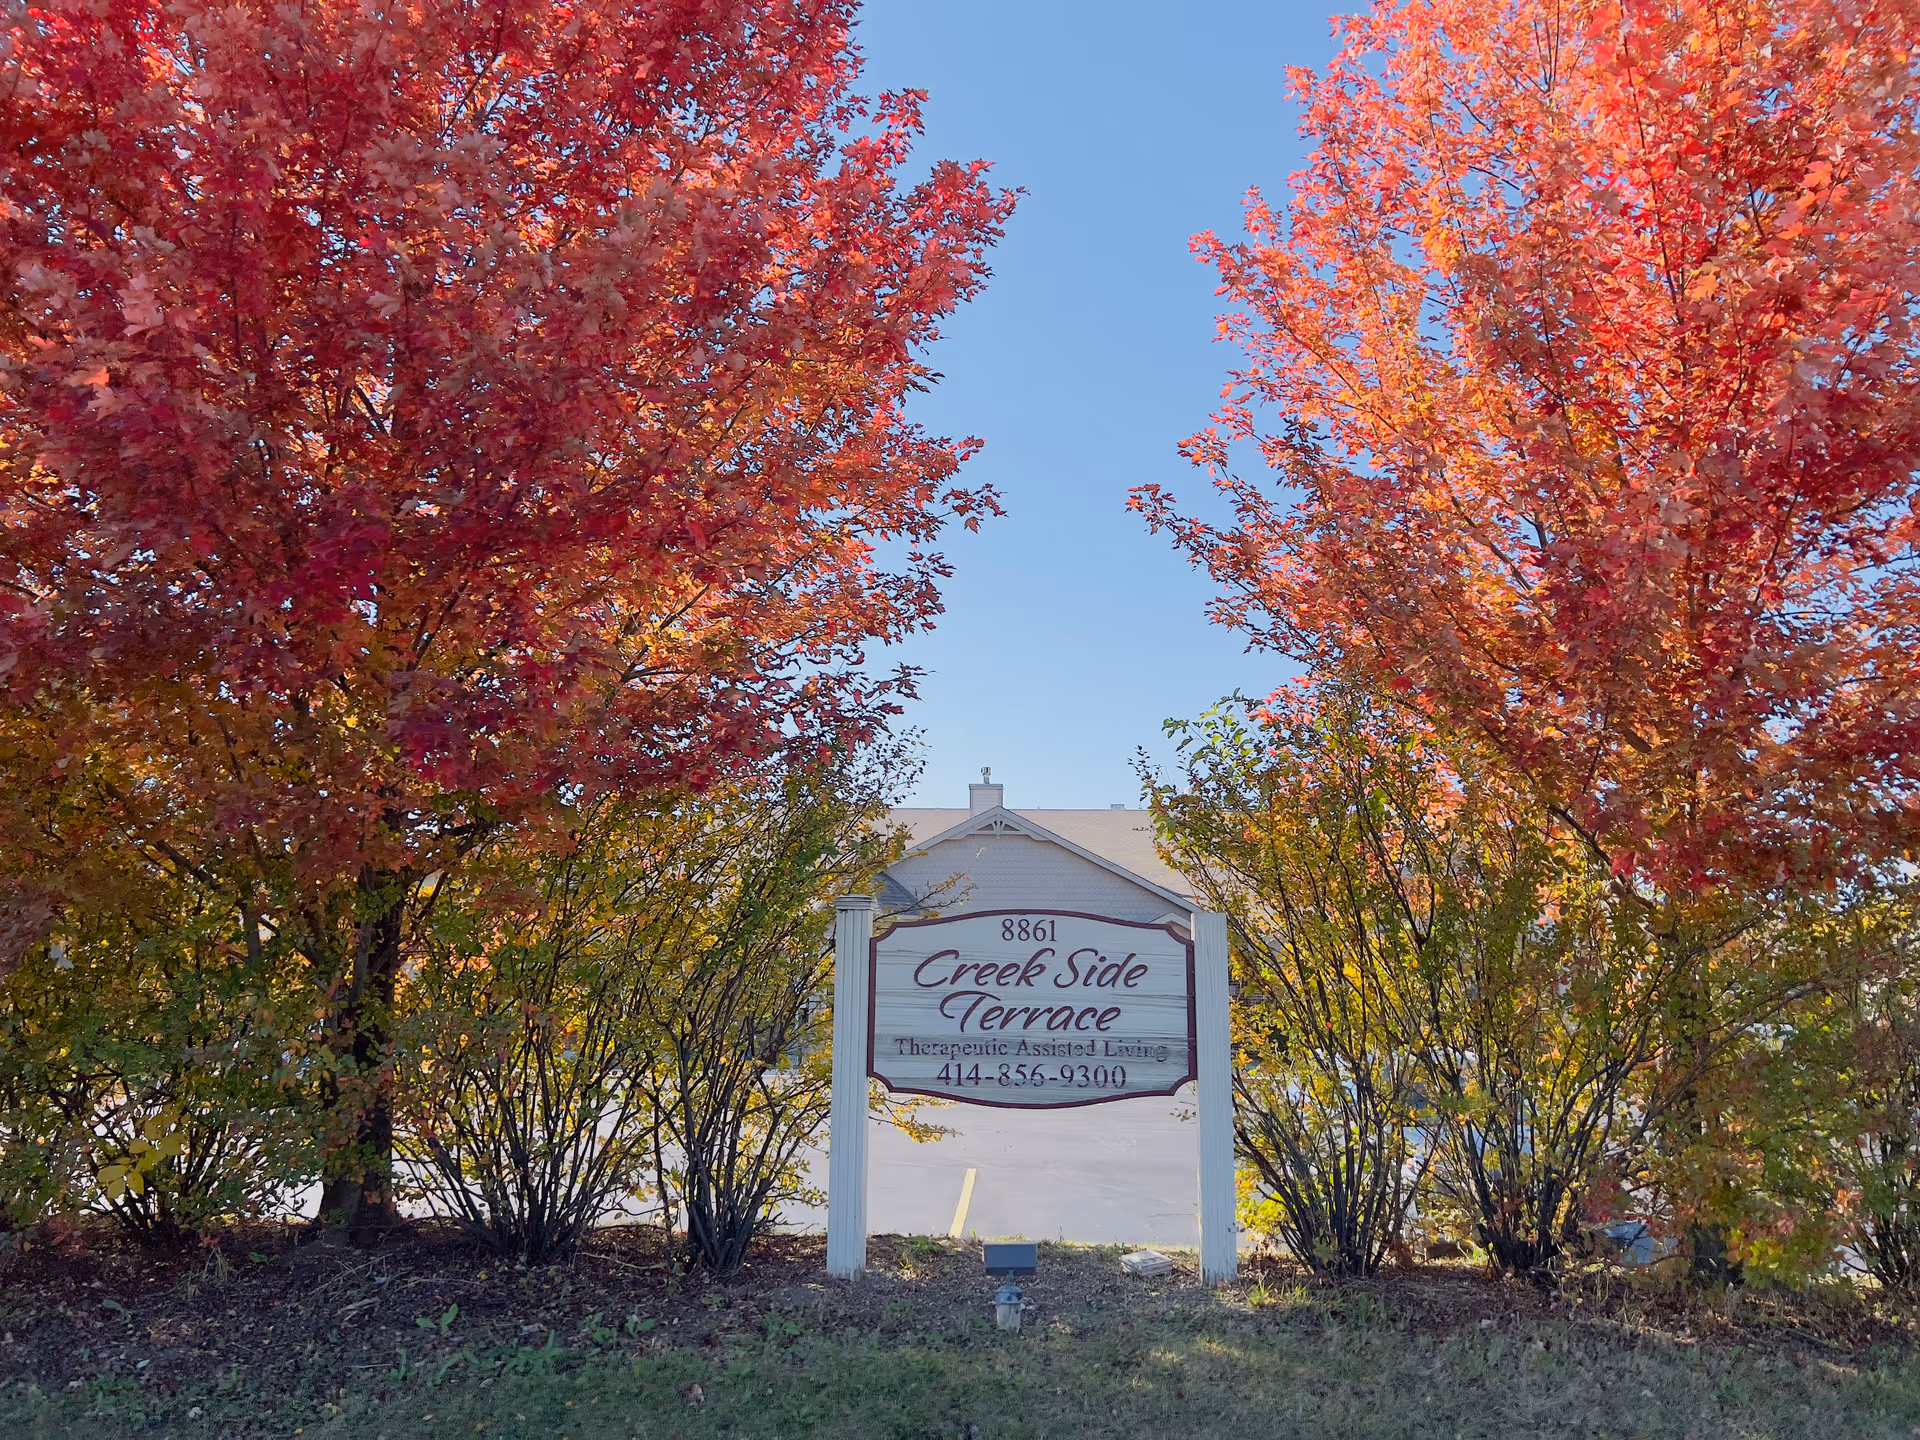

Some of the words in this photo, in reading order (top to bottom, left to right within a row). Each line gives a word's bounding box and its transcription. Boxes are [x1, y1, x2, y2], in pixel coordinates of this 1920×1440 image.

[1001, 918, 1057, 942] 8861
[914, 947, 1056, 989] Creek
[1053, 948, 1149, 989] Side
[939, 990, 1122, 1033] Terrace
[895, 1038, 1008, 1060] Therapeutic
[1016, 1039, 1096, 1057] Assisted
[1104, 1039, 1168, 1062] Living
[937, 1063, 1127, 1089] 414-856-9300
